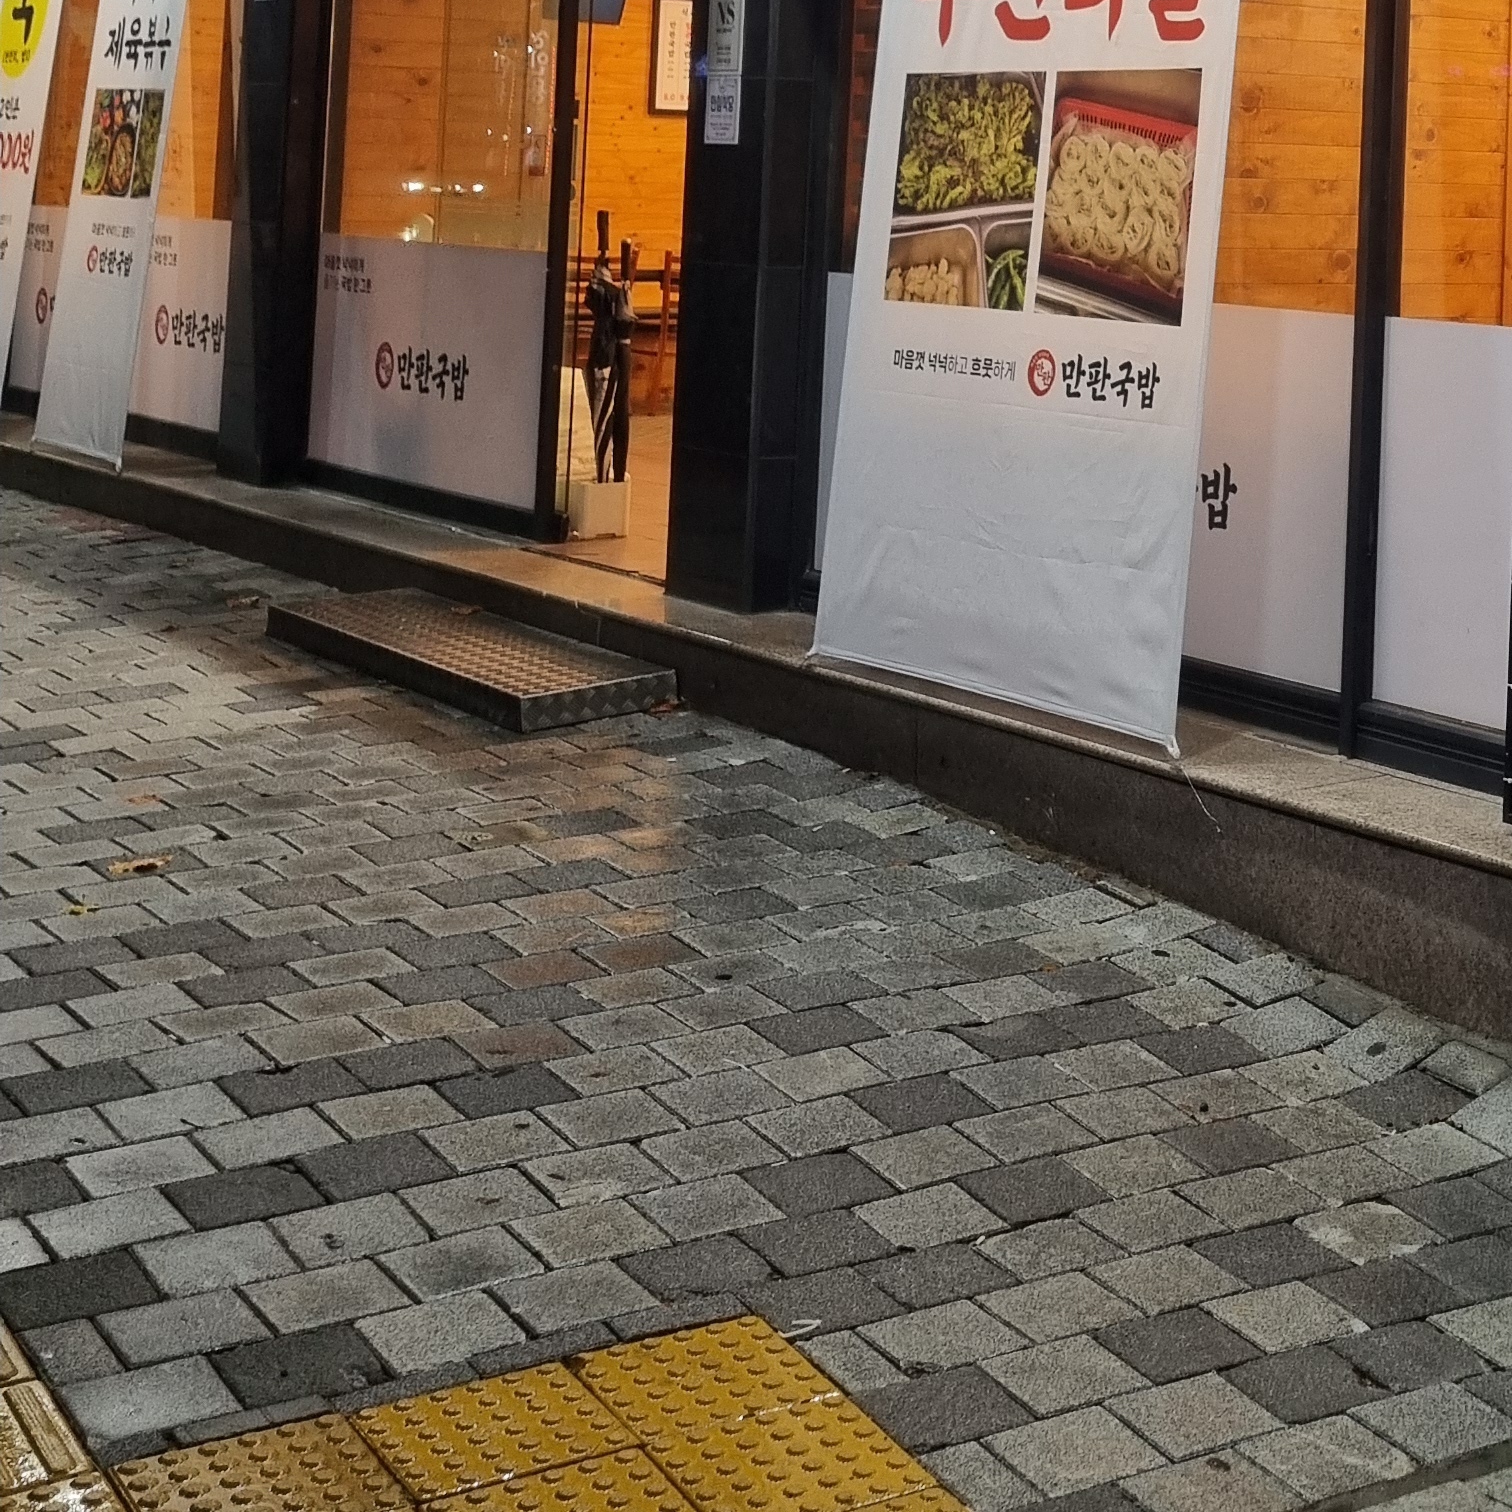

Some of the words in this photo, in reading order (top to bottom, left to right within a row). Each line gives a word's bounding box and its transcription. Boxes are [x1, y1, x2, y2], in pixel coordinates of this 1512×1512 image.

[171, 307, 225, 354] 만판국밥
[397, 345, 470, 403] 만판국밥
[893, 348, 926, 372] 마음껏
[928, 351, 968, 375] 넉넉하고
[969, 356, 1017, 382] 흐뭇하게
[1060, 353, 1161, 410] 만판국밥
